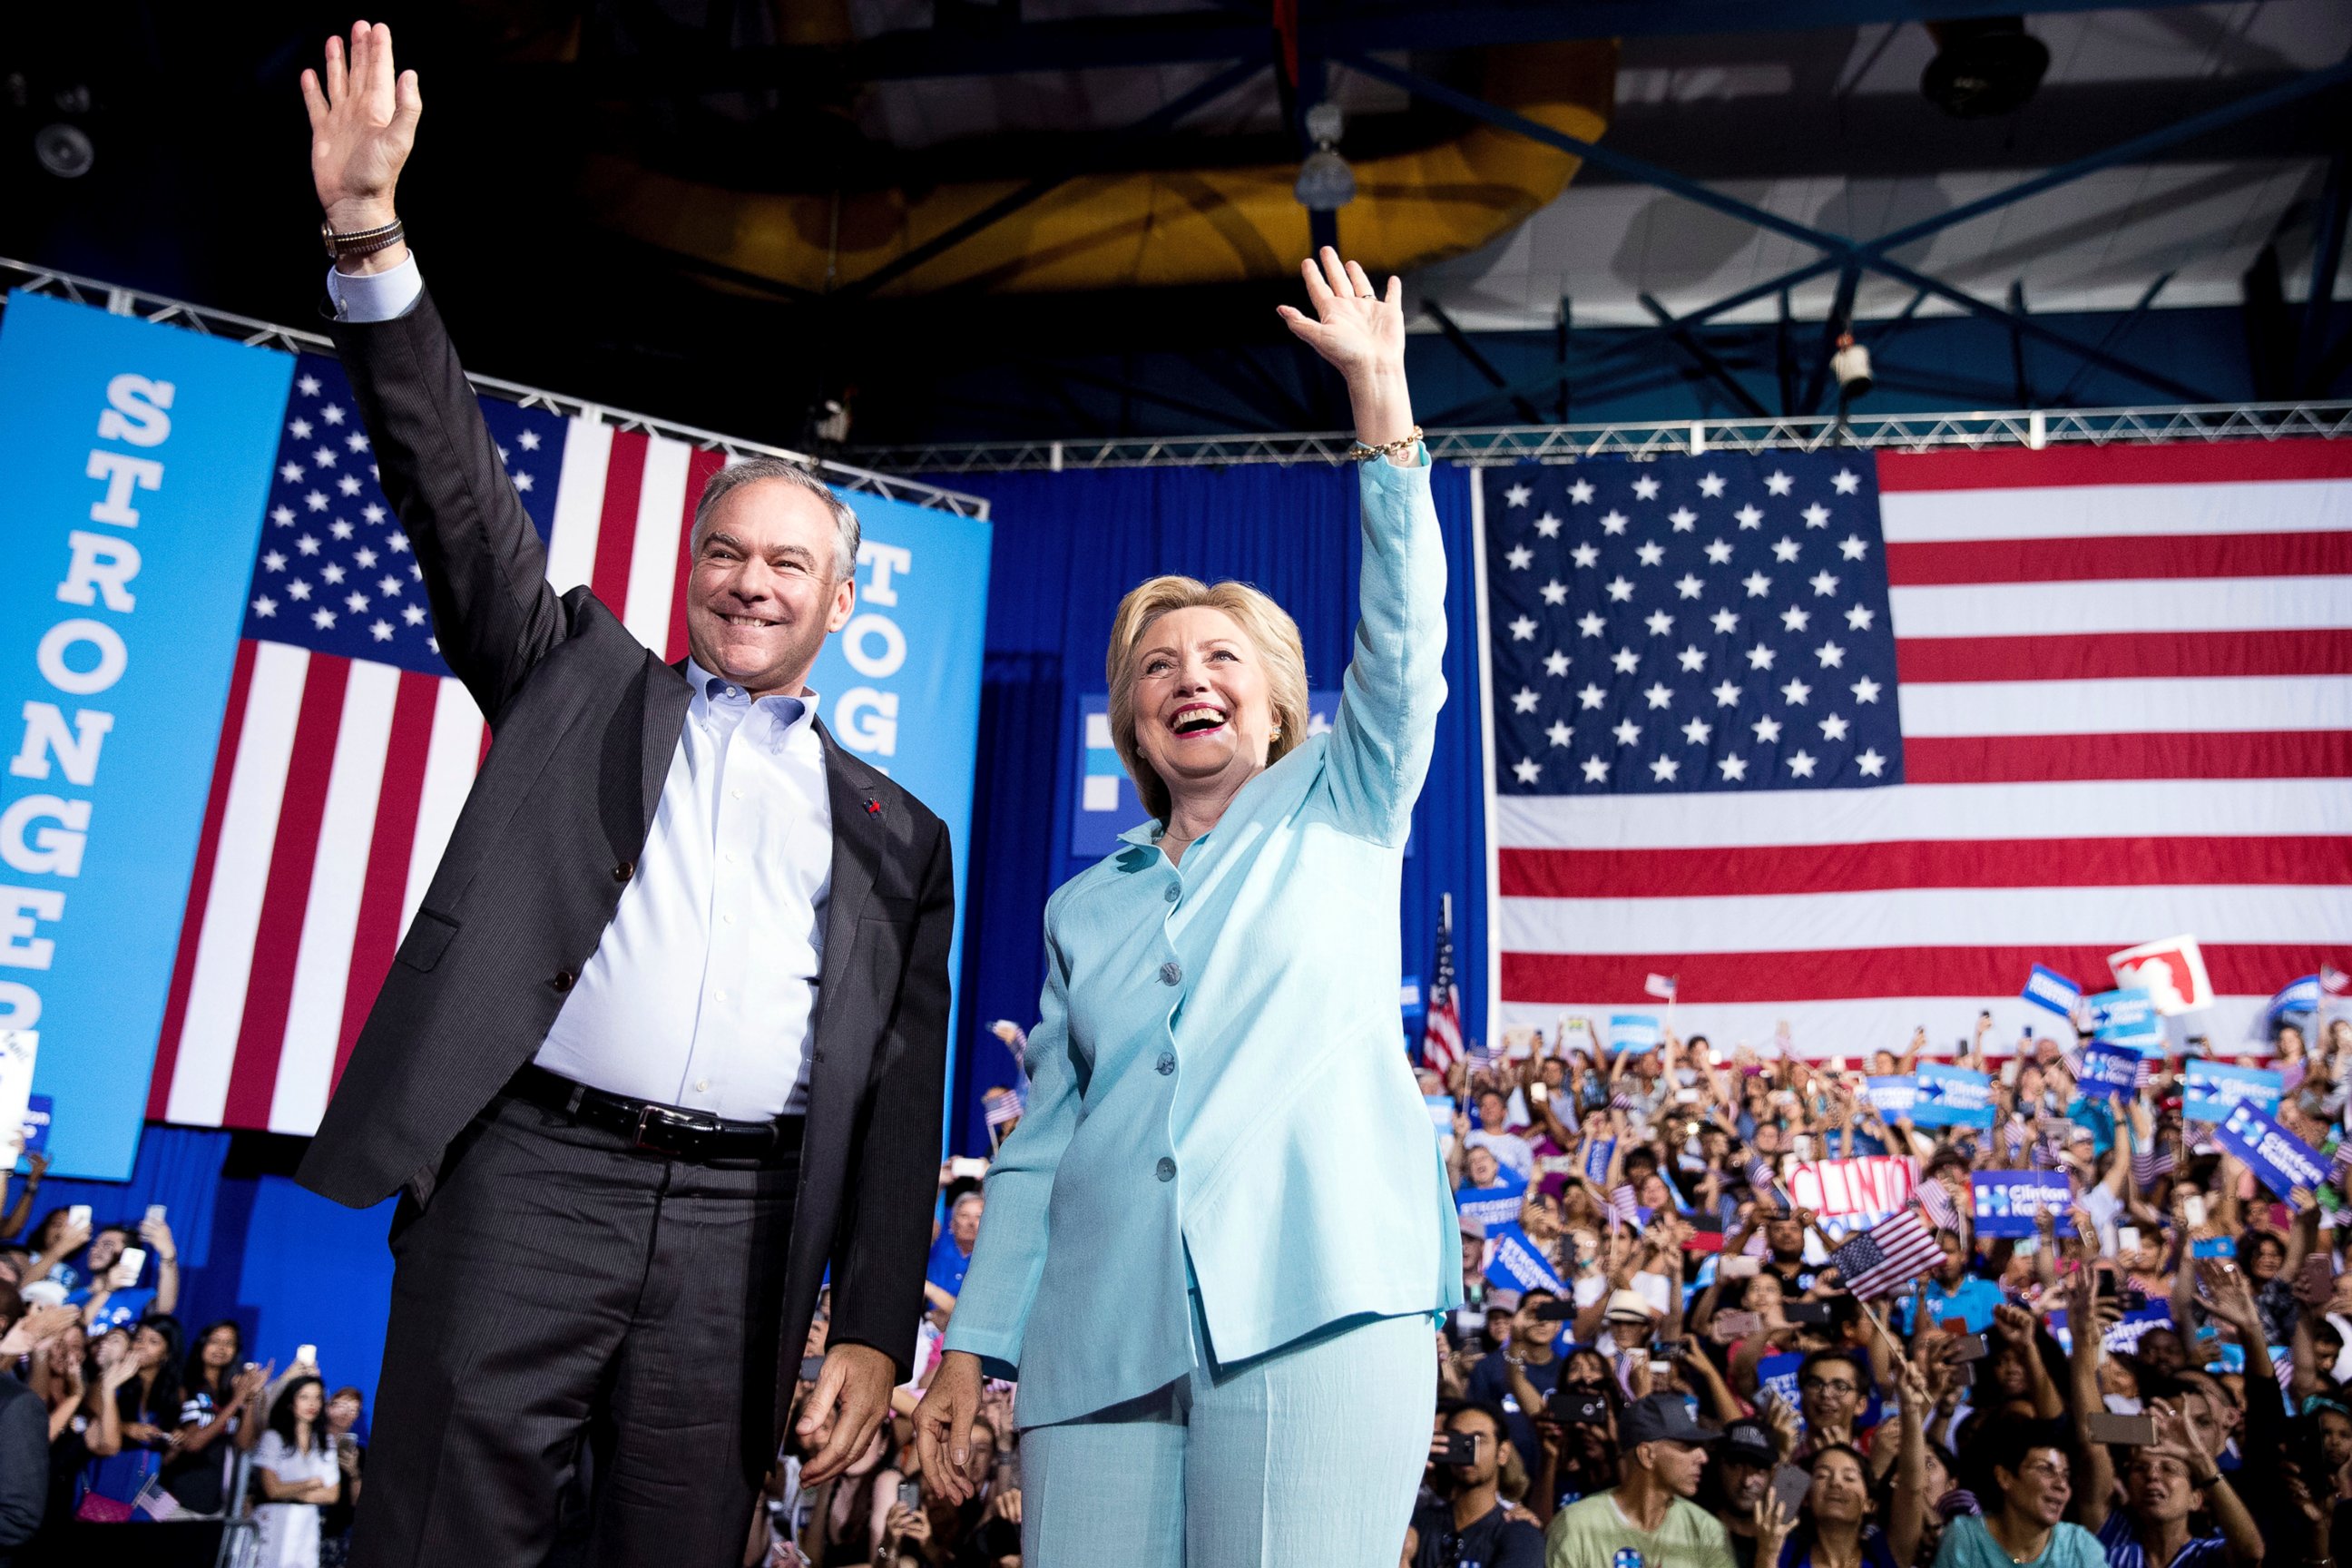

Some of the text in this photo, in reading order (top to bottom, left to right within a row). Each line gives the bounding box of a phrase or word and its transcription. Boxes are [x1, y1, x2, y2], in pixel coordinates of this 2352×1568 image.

[2257, 1142, 2306, 1186] Kaine
[2263, 1132, 2325, 1185] Clinton
[2008, 1183, 2071, 1203] Clinton
